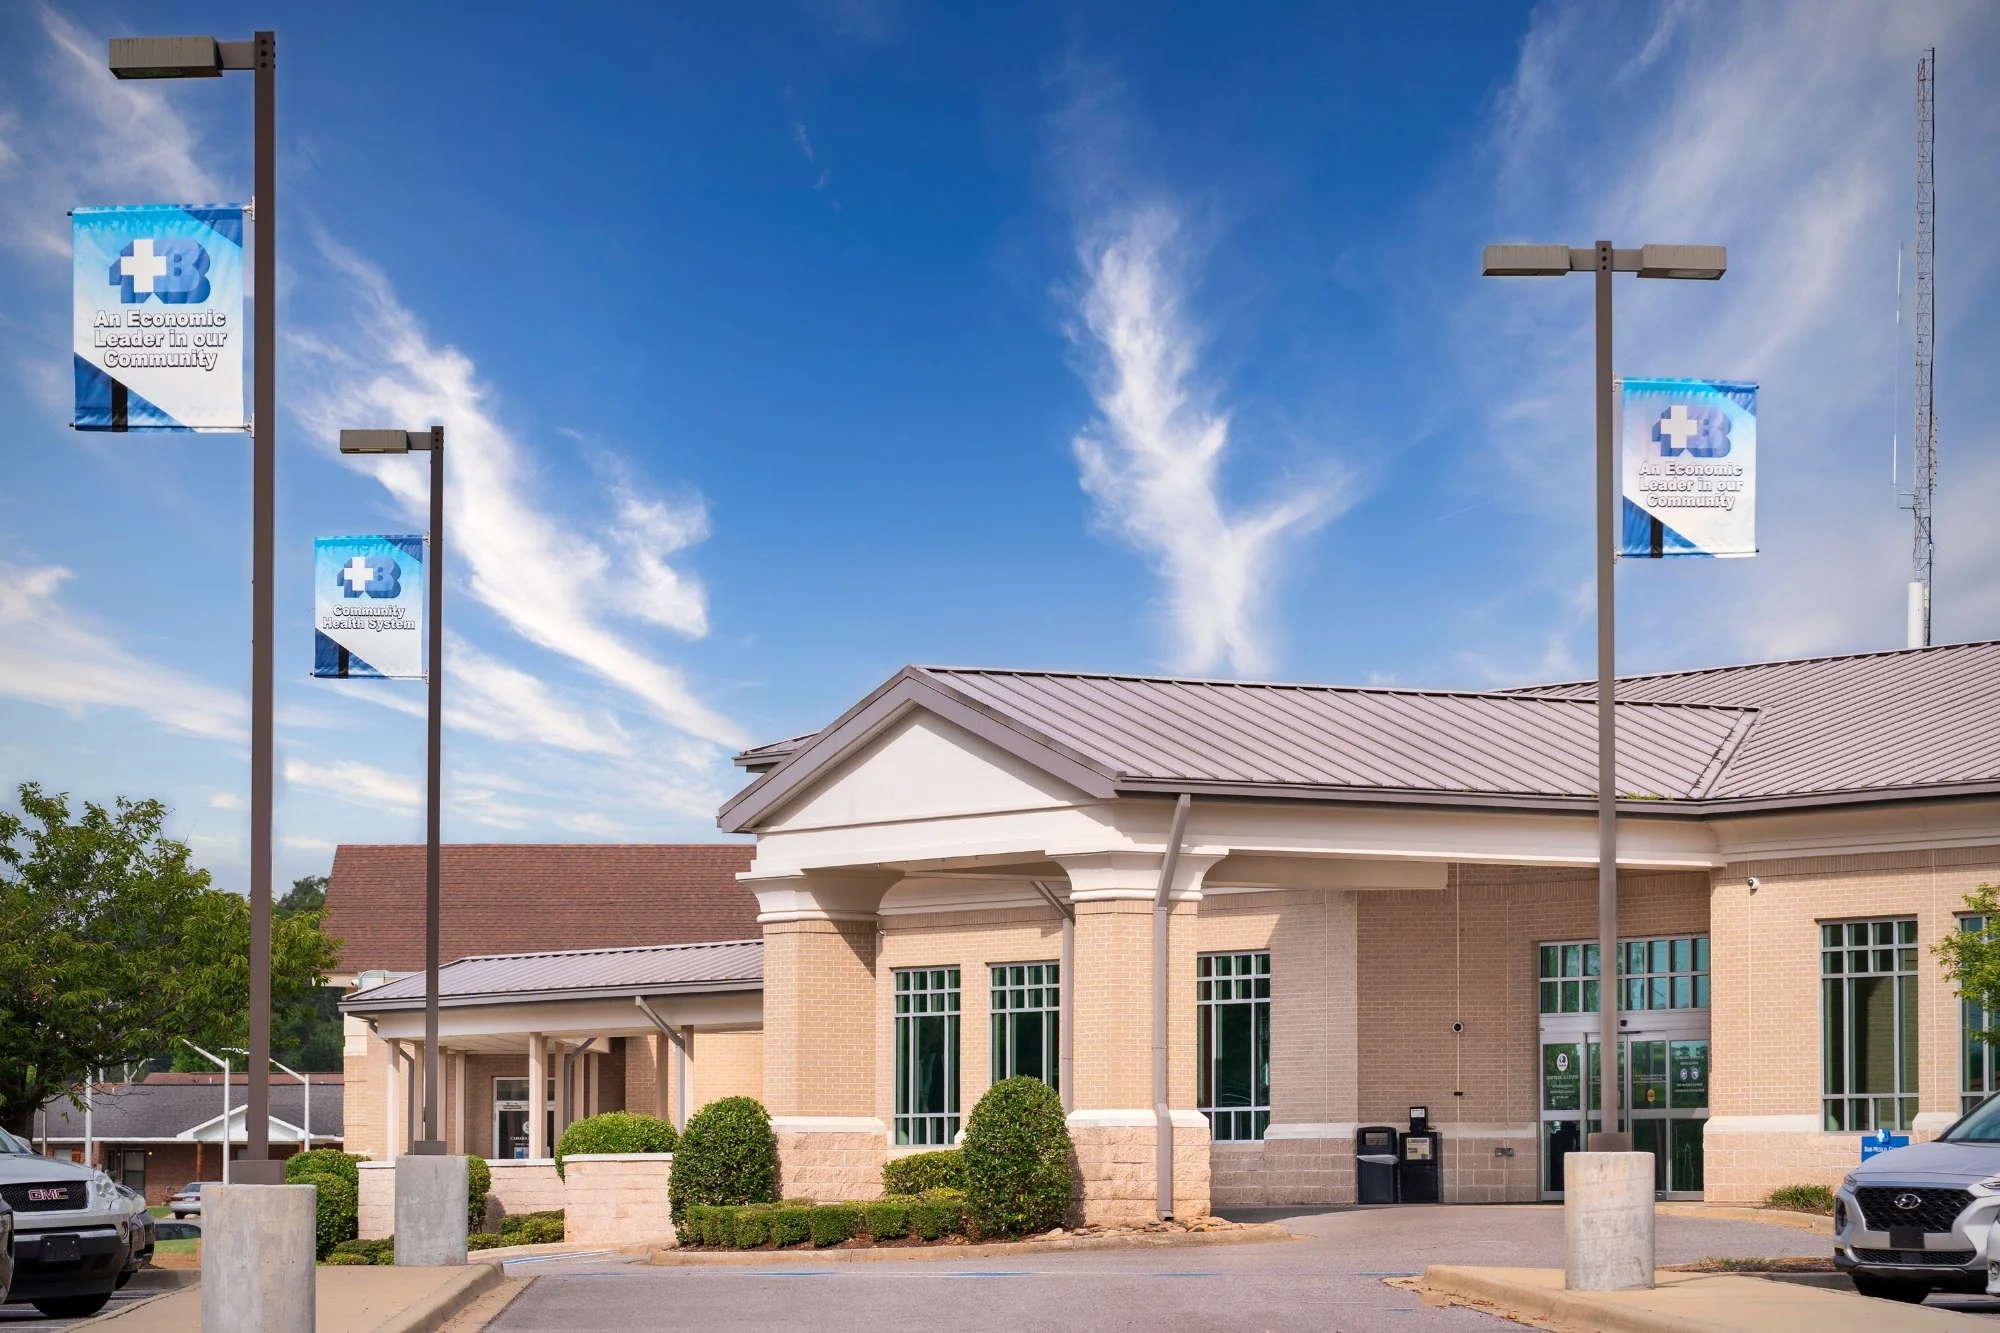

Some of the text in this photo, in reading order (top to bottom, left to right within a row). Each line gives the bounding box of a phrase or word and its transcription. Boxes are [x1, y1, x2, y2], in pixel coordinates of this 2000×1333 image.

[94, 309, 226, 328] An Economic
[94, 330, 227, 348] Leader in our
[104, 350, 217, 371] Community
[1639, 461, 1742, 476] An Economic
[1639, 477, 1743, 492] Leader in our
[1646, 493, 1735, 511] Community
[333, 605, 405, 619] Community
[322, 617, 415, 632] Health System
[28, 1187, 69, 1201] GMC
